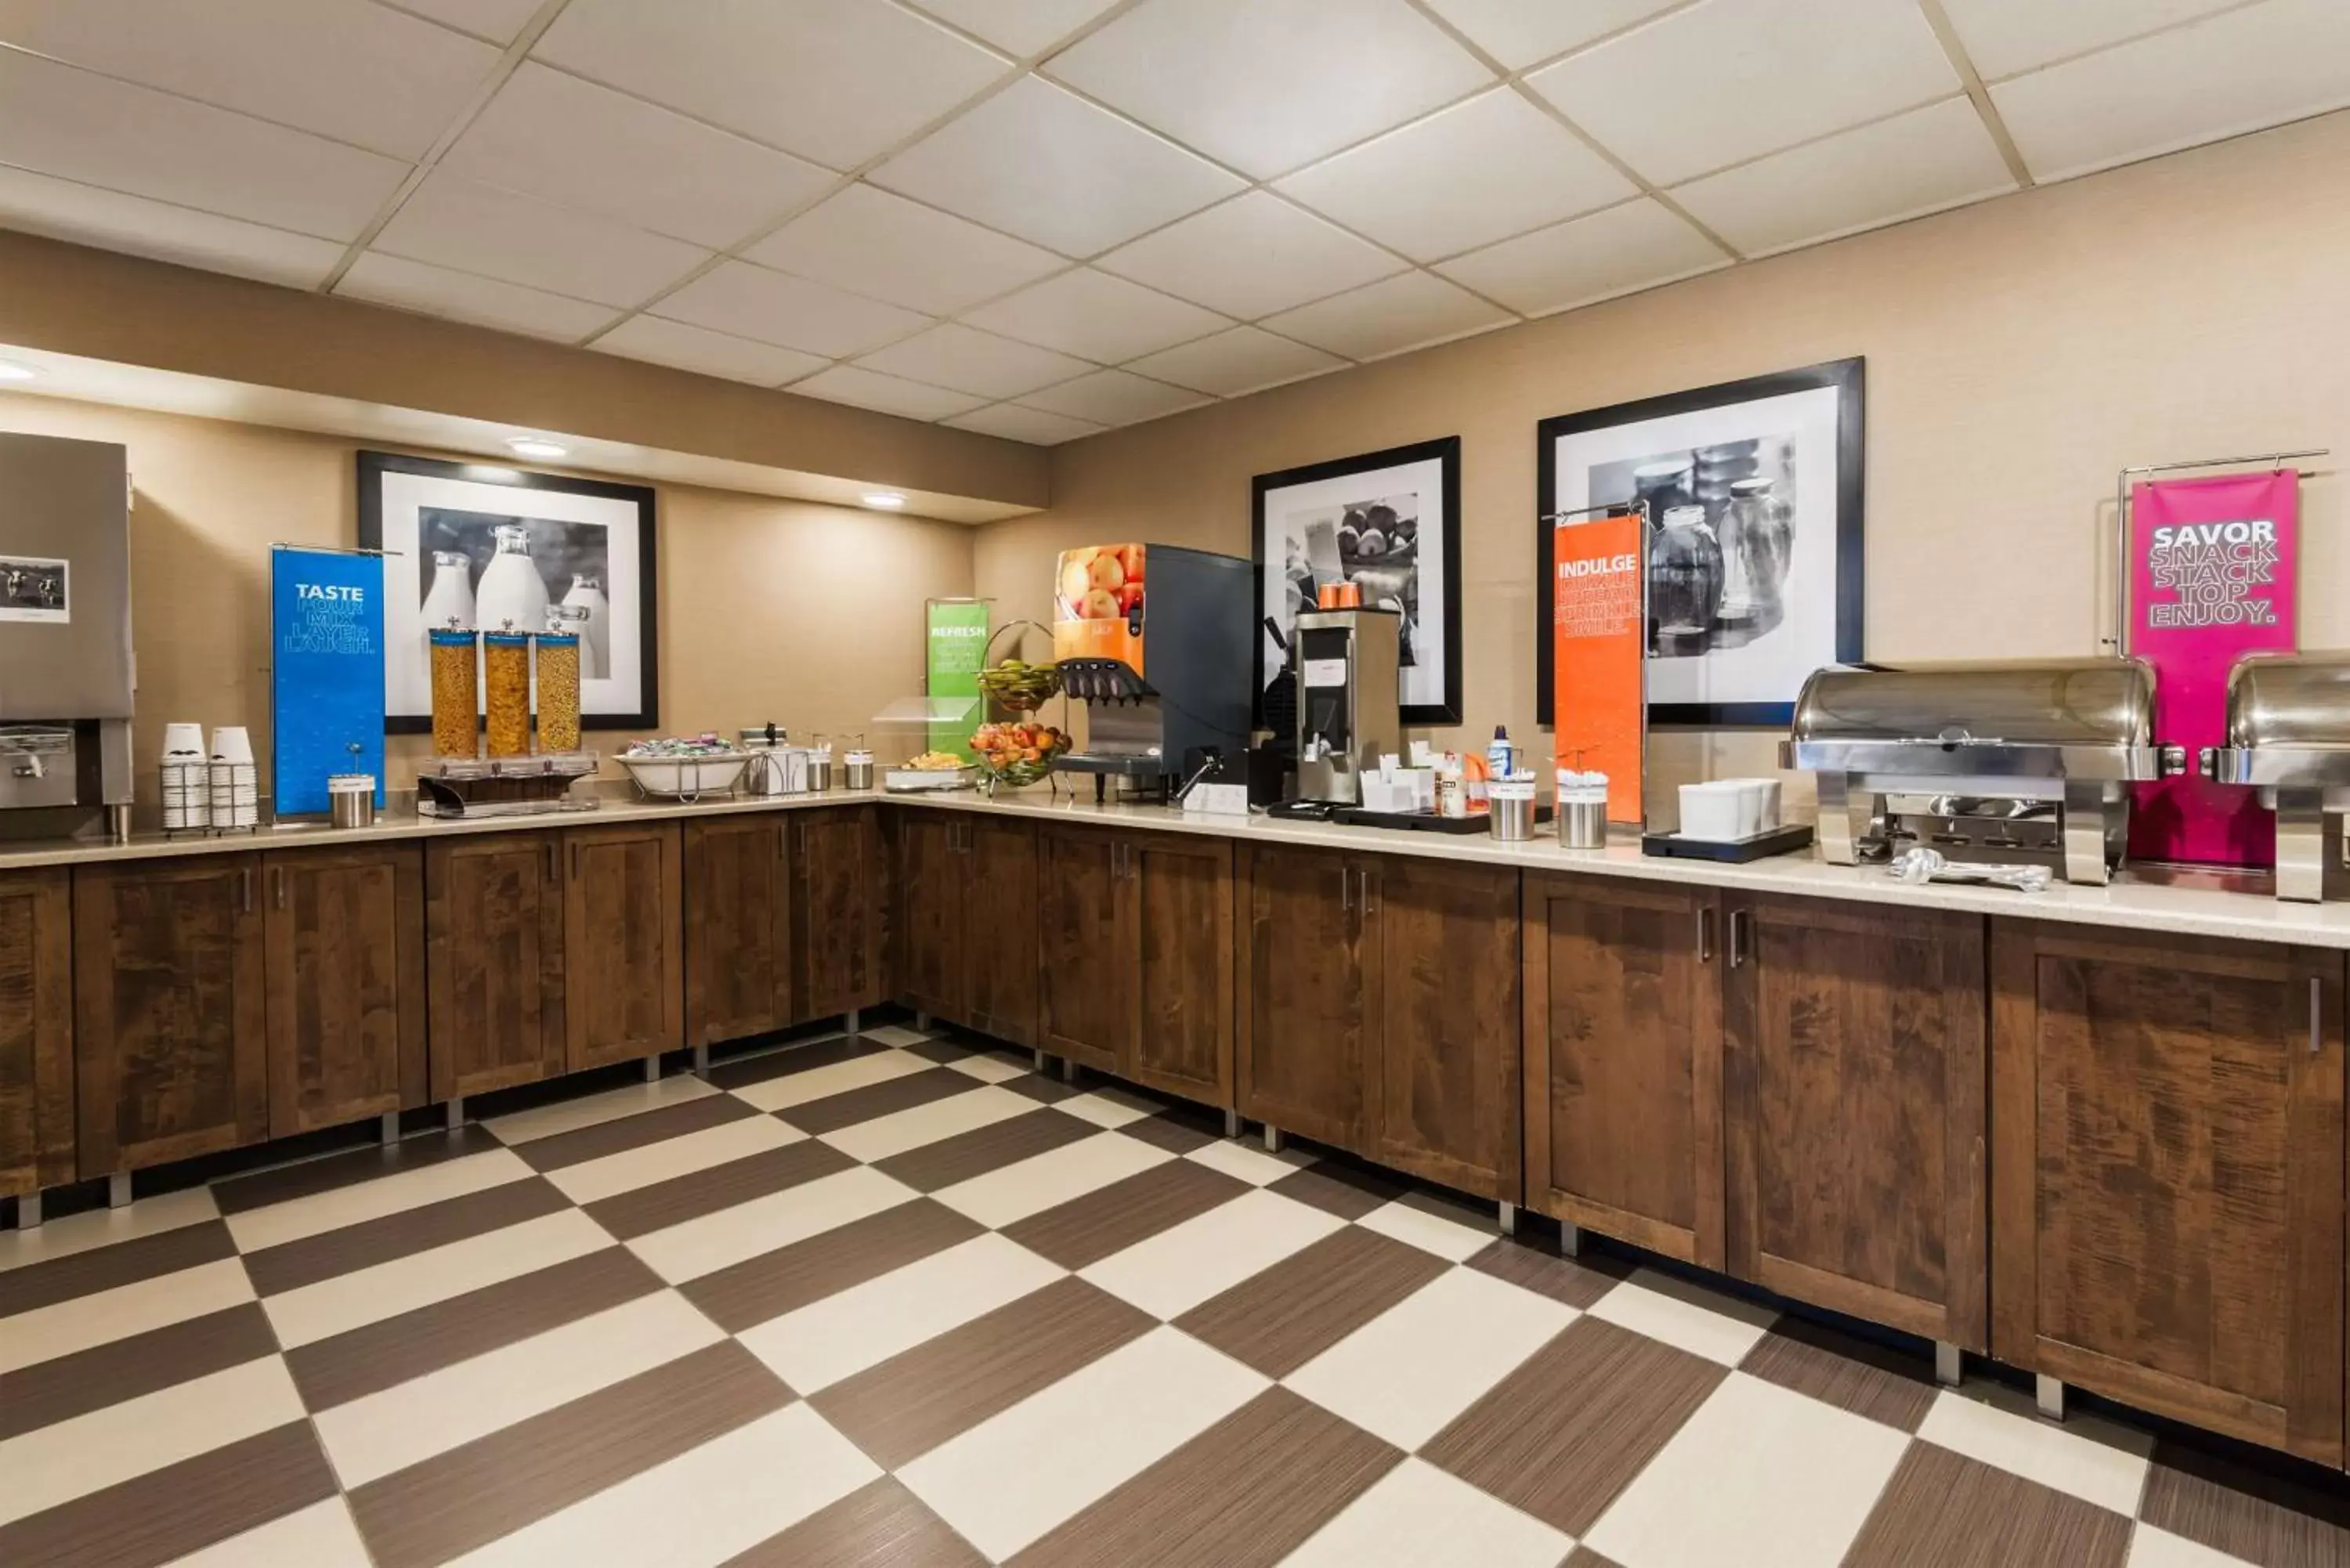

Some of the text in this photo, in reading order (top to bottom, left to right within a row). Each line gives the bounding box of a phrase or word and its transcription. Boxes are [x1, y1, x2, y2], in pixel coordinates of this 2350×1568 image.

[2154, 521, 2274, 547] SAVOR
[2149, 538, 2279, 568] SNACK
[1559, 555, 1636, 578] INDULGE
[2154, 561, 2274, 587] STACK
[296, 584, 363, 601] TASTE
[2177, 582, 2248, 604] TOP
[2150, 601, 2276, 627] ENJOY.
